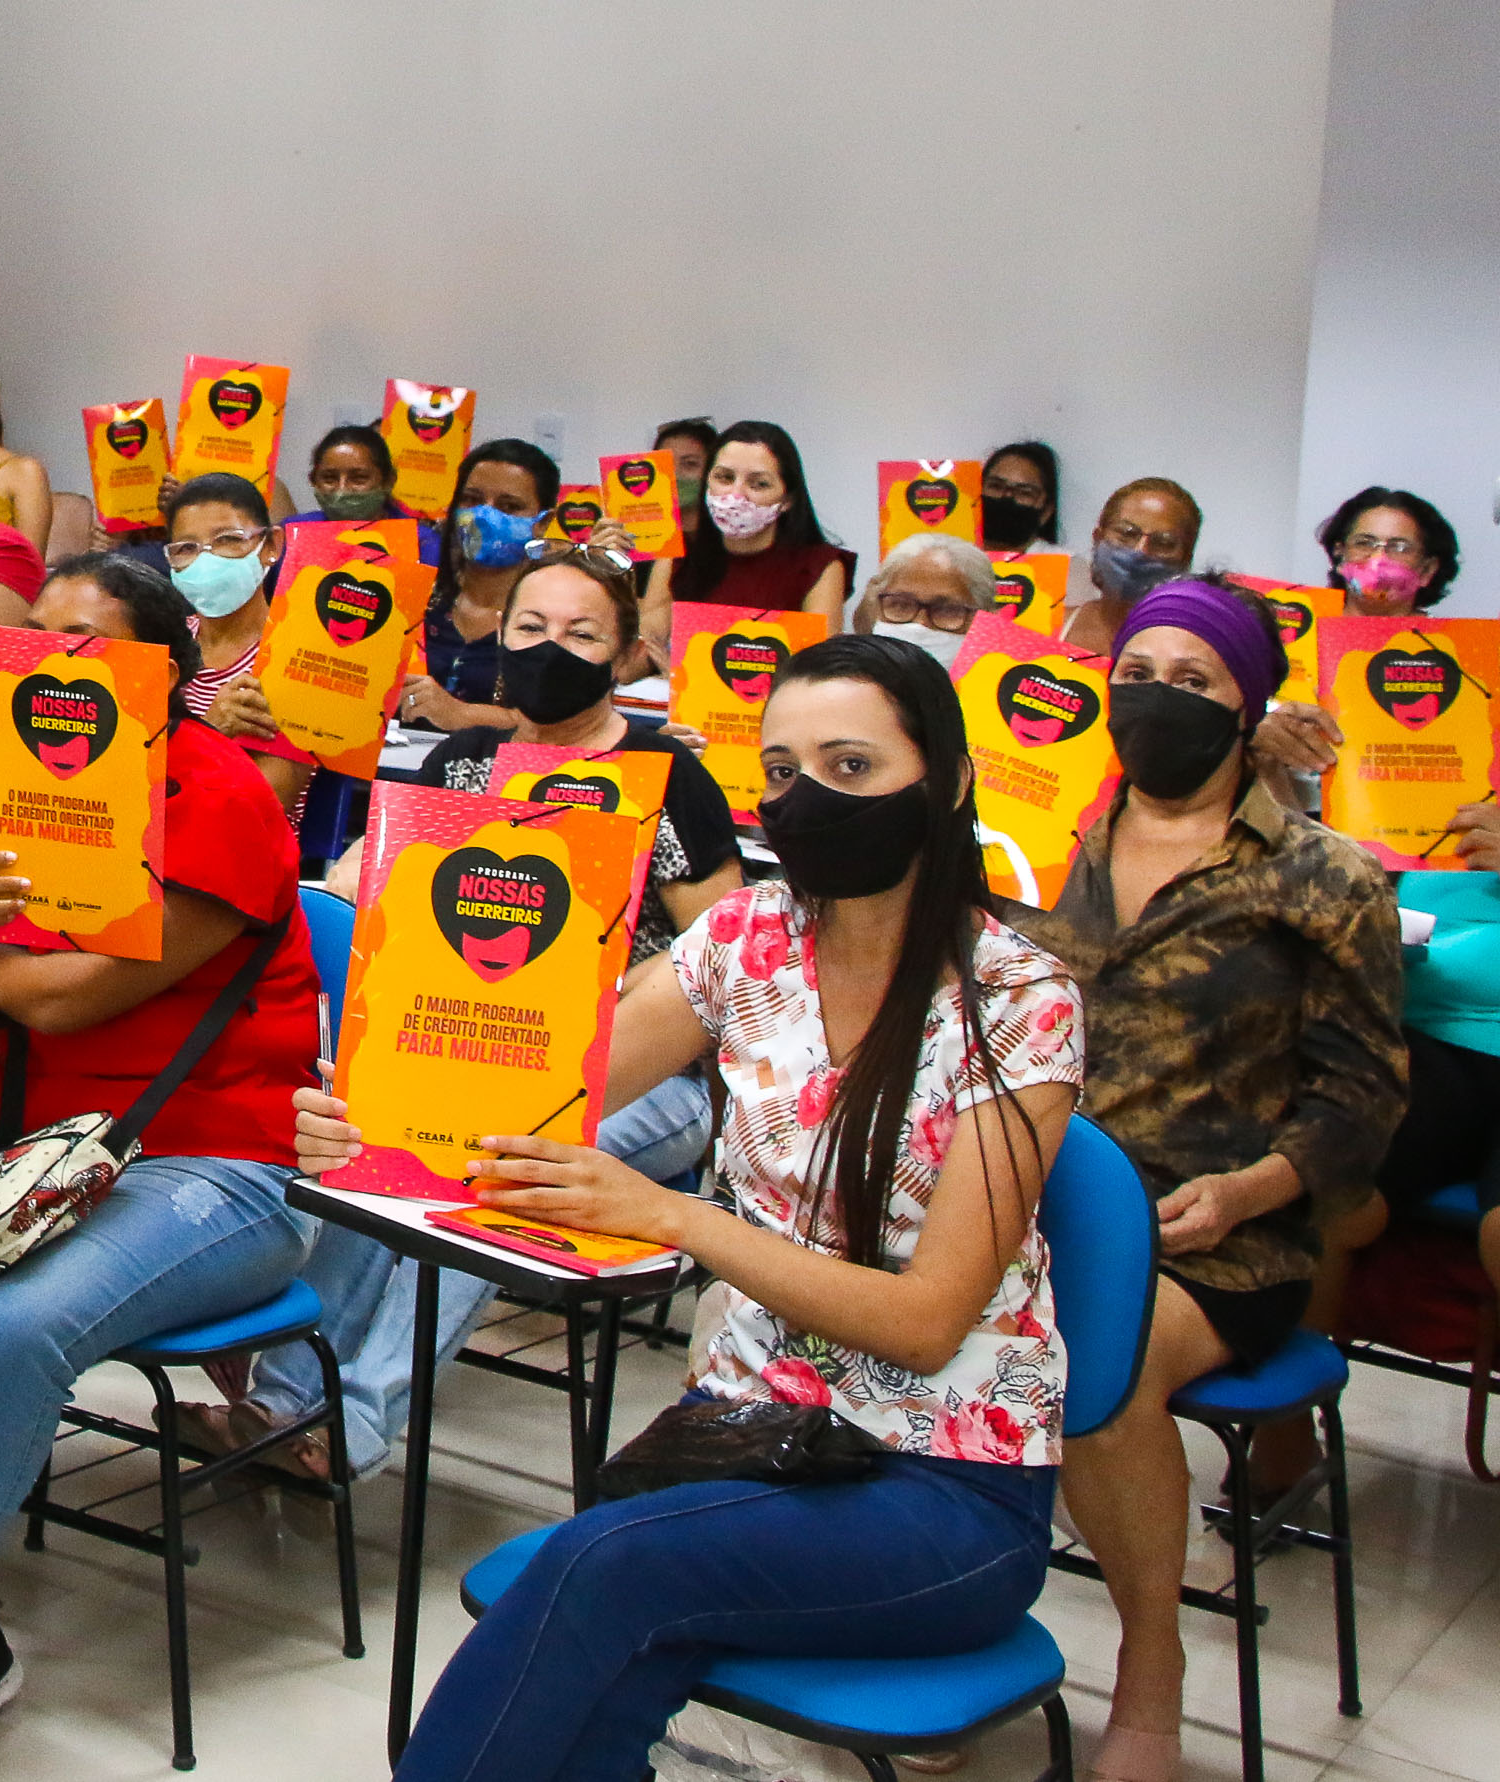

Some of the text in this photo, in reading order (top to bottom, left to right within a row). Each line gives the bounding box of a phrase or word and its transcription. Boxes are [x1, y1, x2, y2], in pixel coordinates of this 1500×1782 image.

[1017, 678, 1084, 712] NOSSAS
[31, 696, 98, 721] NOSSAS
[31, 716, 97, 735] GUERREIRAS
[8, 789, 108, 815] O MAIOR PROGRAMA
[545, 788, 605, 804] NOSSAS
[2, 803, 114, 830] DE CRÉDITO ORIENTADO
[0, 817, 116, 849] PARA MULHERES.
[478, 867, 531, 881] PROGRAMA
[458, 874, 546, 908] NOSSAS
[456, 900, 543, 926] GUERREIRAS
[414, 994, 544, 1027] O MAIOR PROGRAMA
[404, 1013, 550, 1047] DE CRÉDITO ORIENTADO
[396, 1030, 551, 1072] PARA MULHERES.
[417, 1131, 454, 1143] CEARÁ
